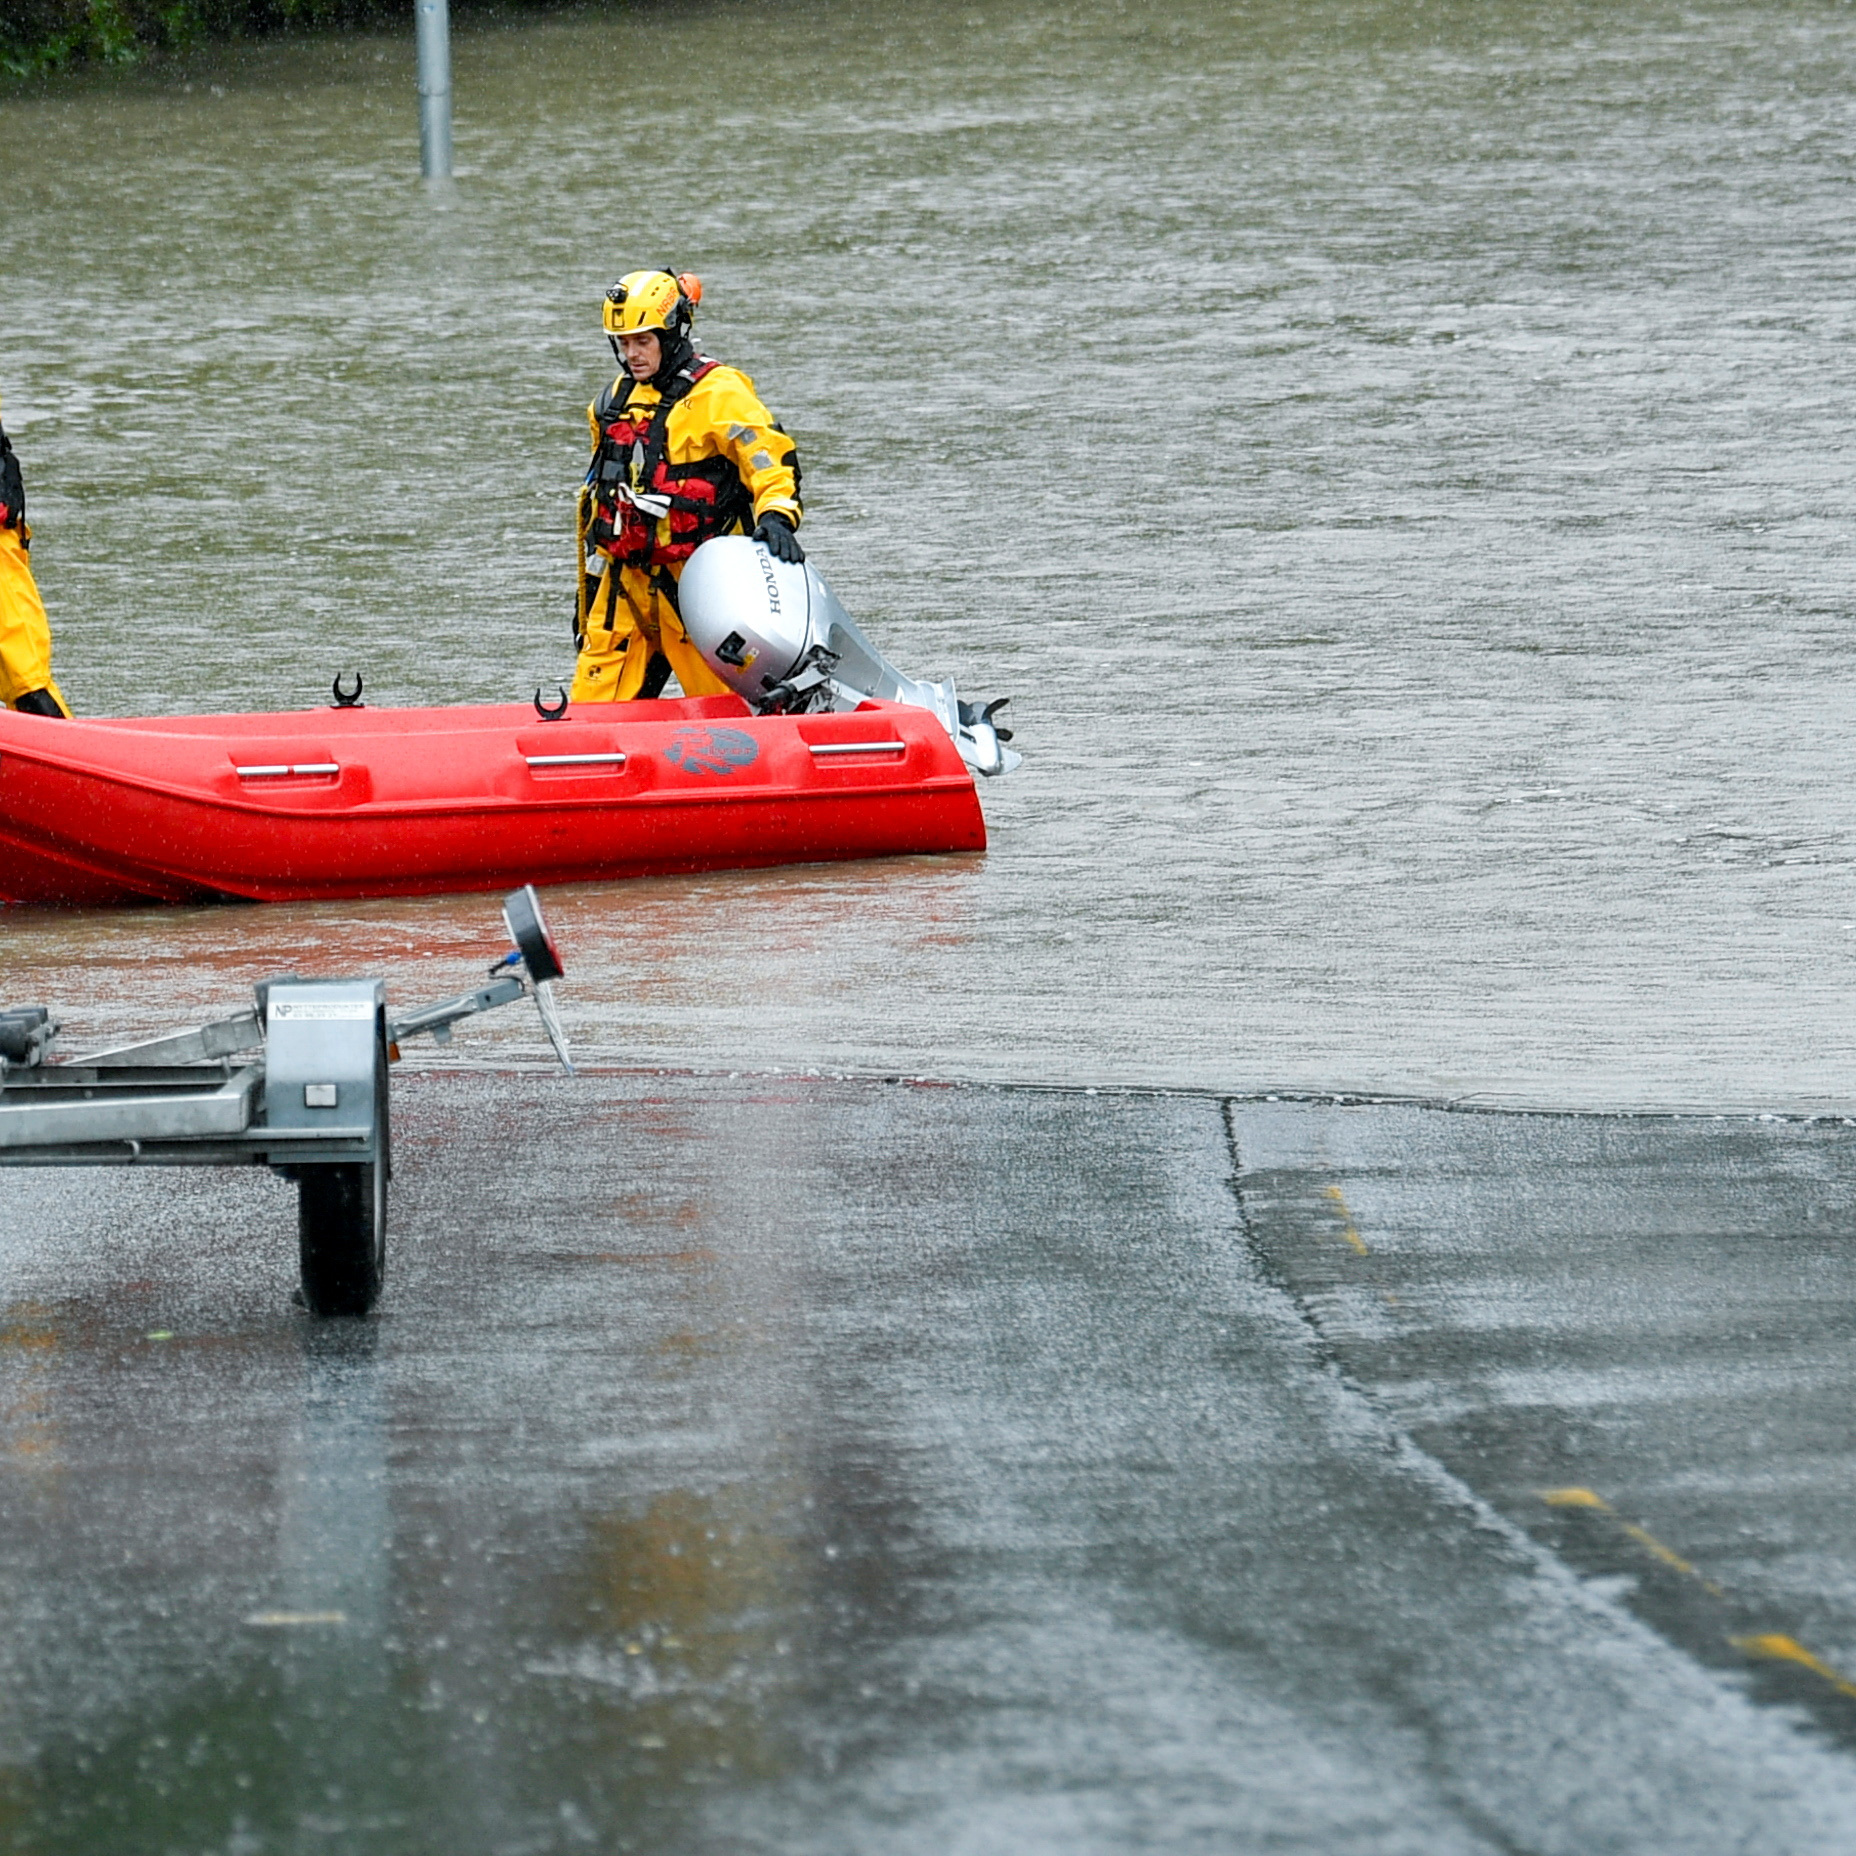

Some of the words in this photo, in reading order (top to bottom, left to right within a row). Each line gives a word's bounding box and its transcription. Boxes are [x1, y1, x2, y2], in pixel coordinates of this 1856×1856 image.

[656, 286, 678, 317] NRBR
[756, 547, 781, 615] HONDA
[275, 1005, 293, 1018] NP
